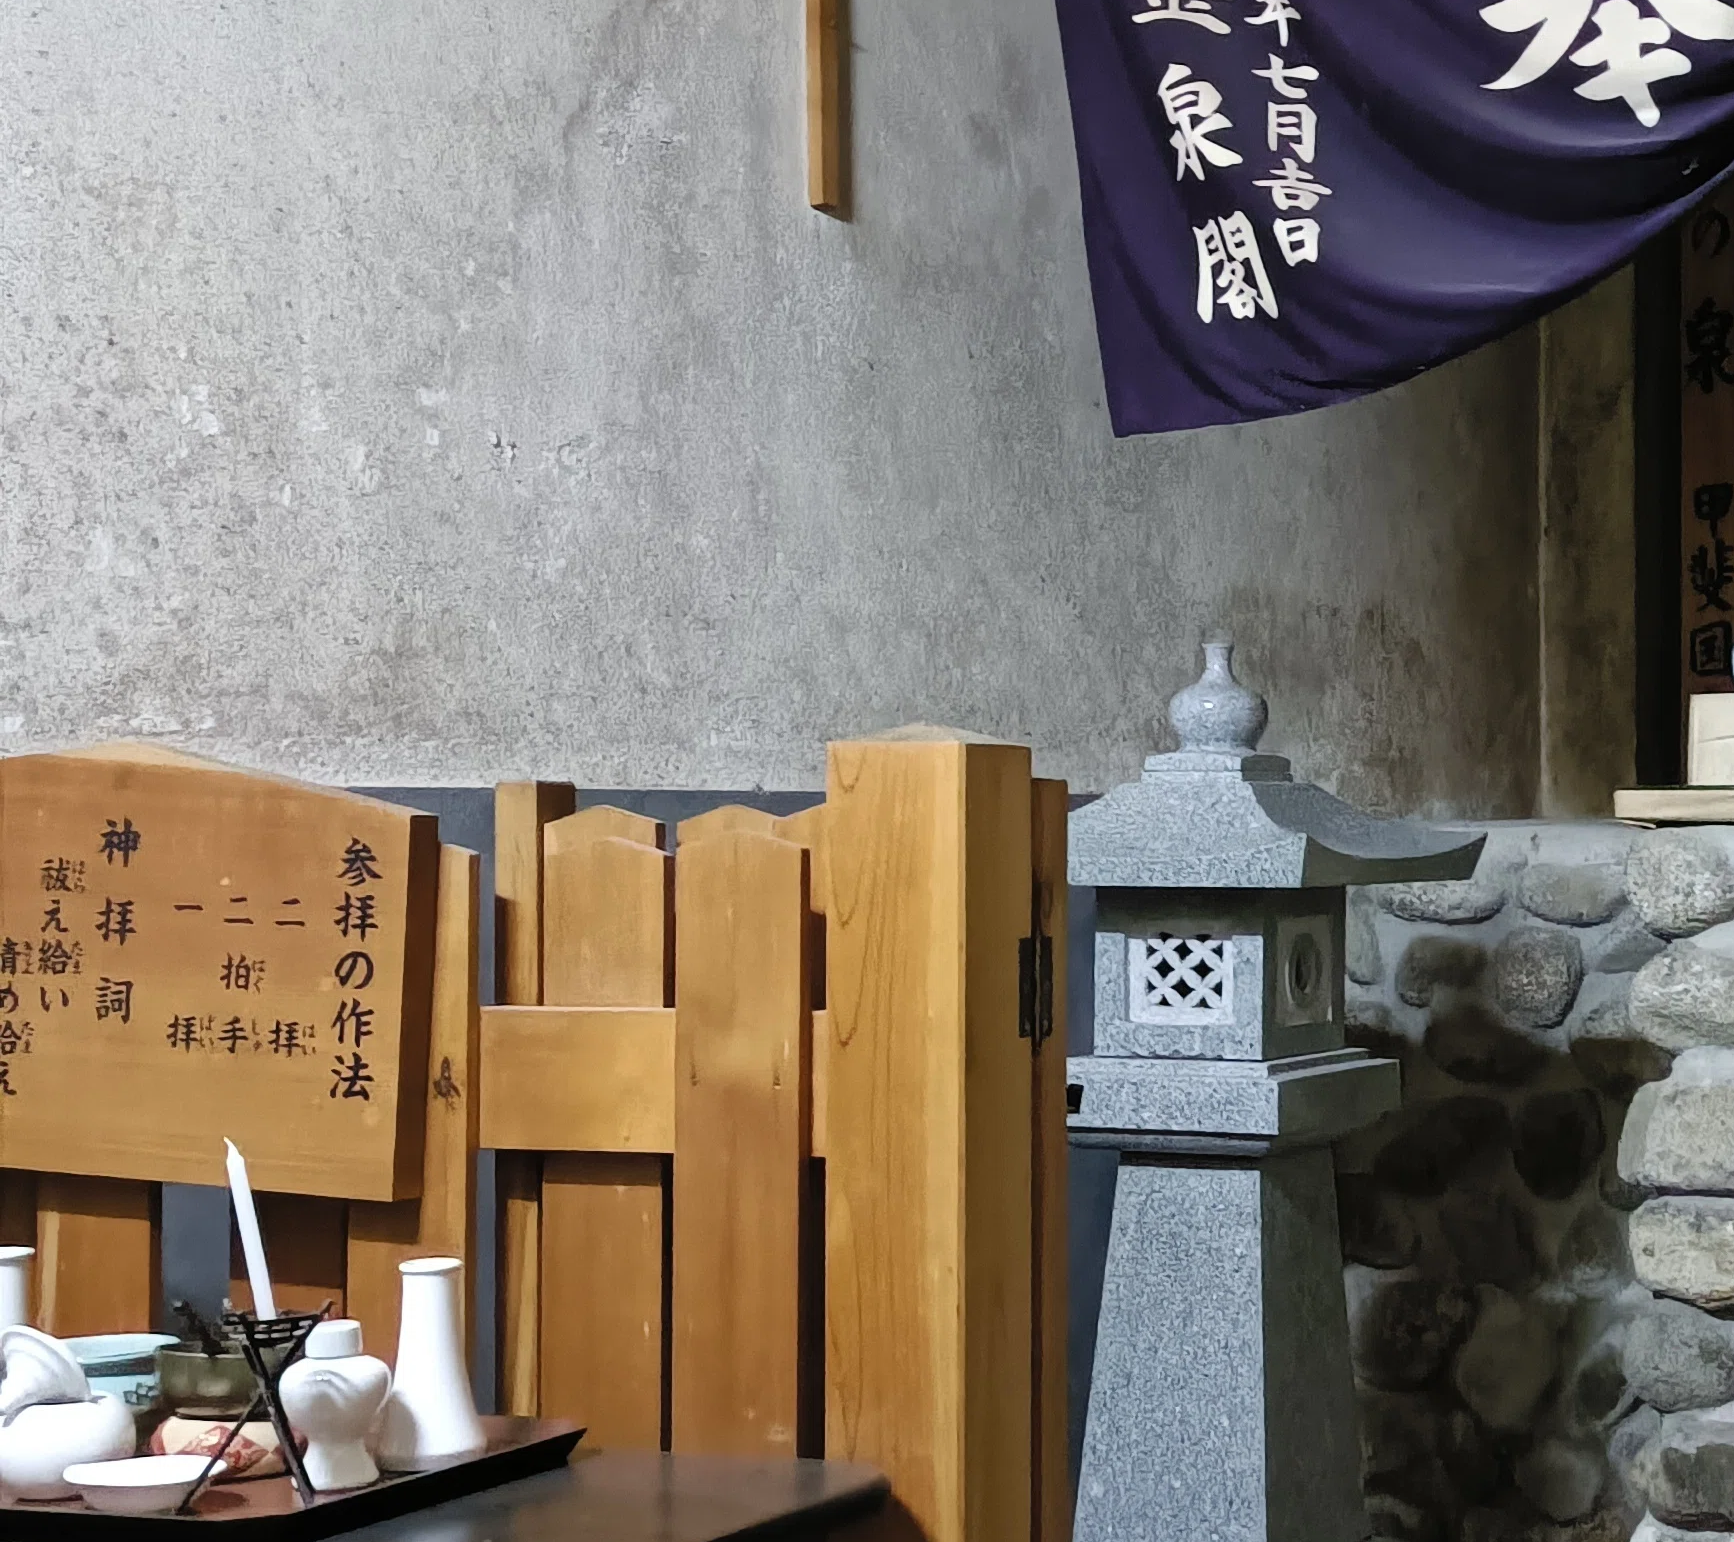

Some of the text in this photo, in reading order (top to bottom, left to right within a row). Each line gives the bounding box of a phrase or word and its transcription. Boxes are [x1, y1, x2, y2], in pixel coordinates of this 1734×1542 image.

[95, 817, 141, 1024] 神拝詞
[330, 838, 382, 1101] 参拝の作法
